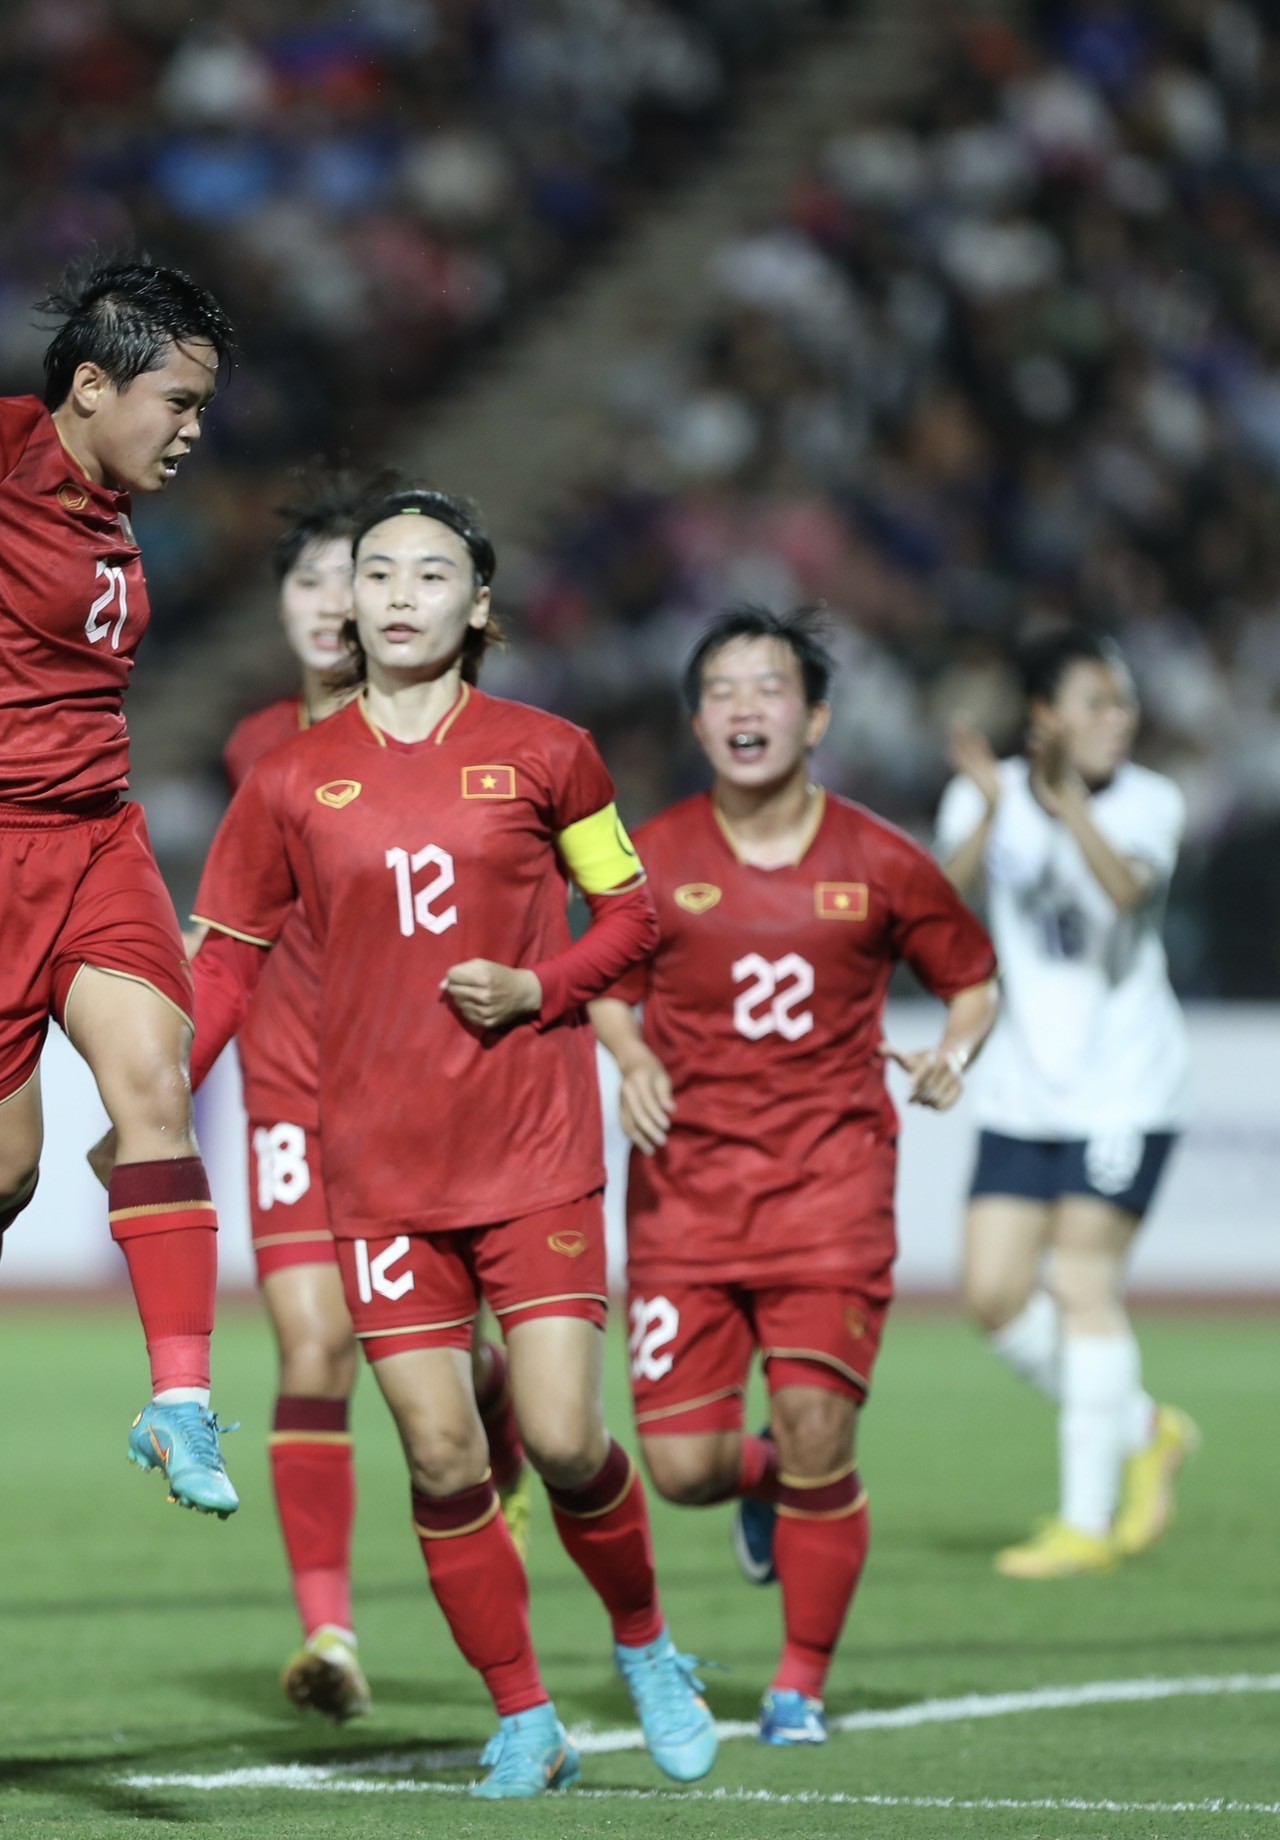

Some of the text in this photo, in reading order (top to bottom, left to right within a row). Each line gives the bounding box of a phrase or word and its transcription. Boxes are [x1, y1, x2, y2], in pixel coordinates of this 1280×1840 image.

[84, 558, 128, 650] 21
[385, 843, 458, 938] 12
[731, 952, 815, 1041] 22
[252, 1121, 312, 1211] 18
[353, 1235, 415, 1304] 12
